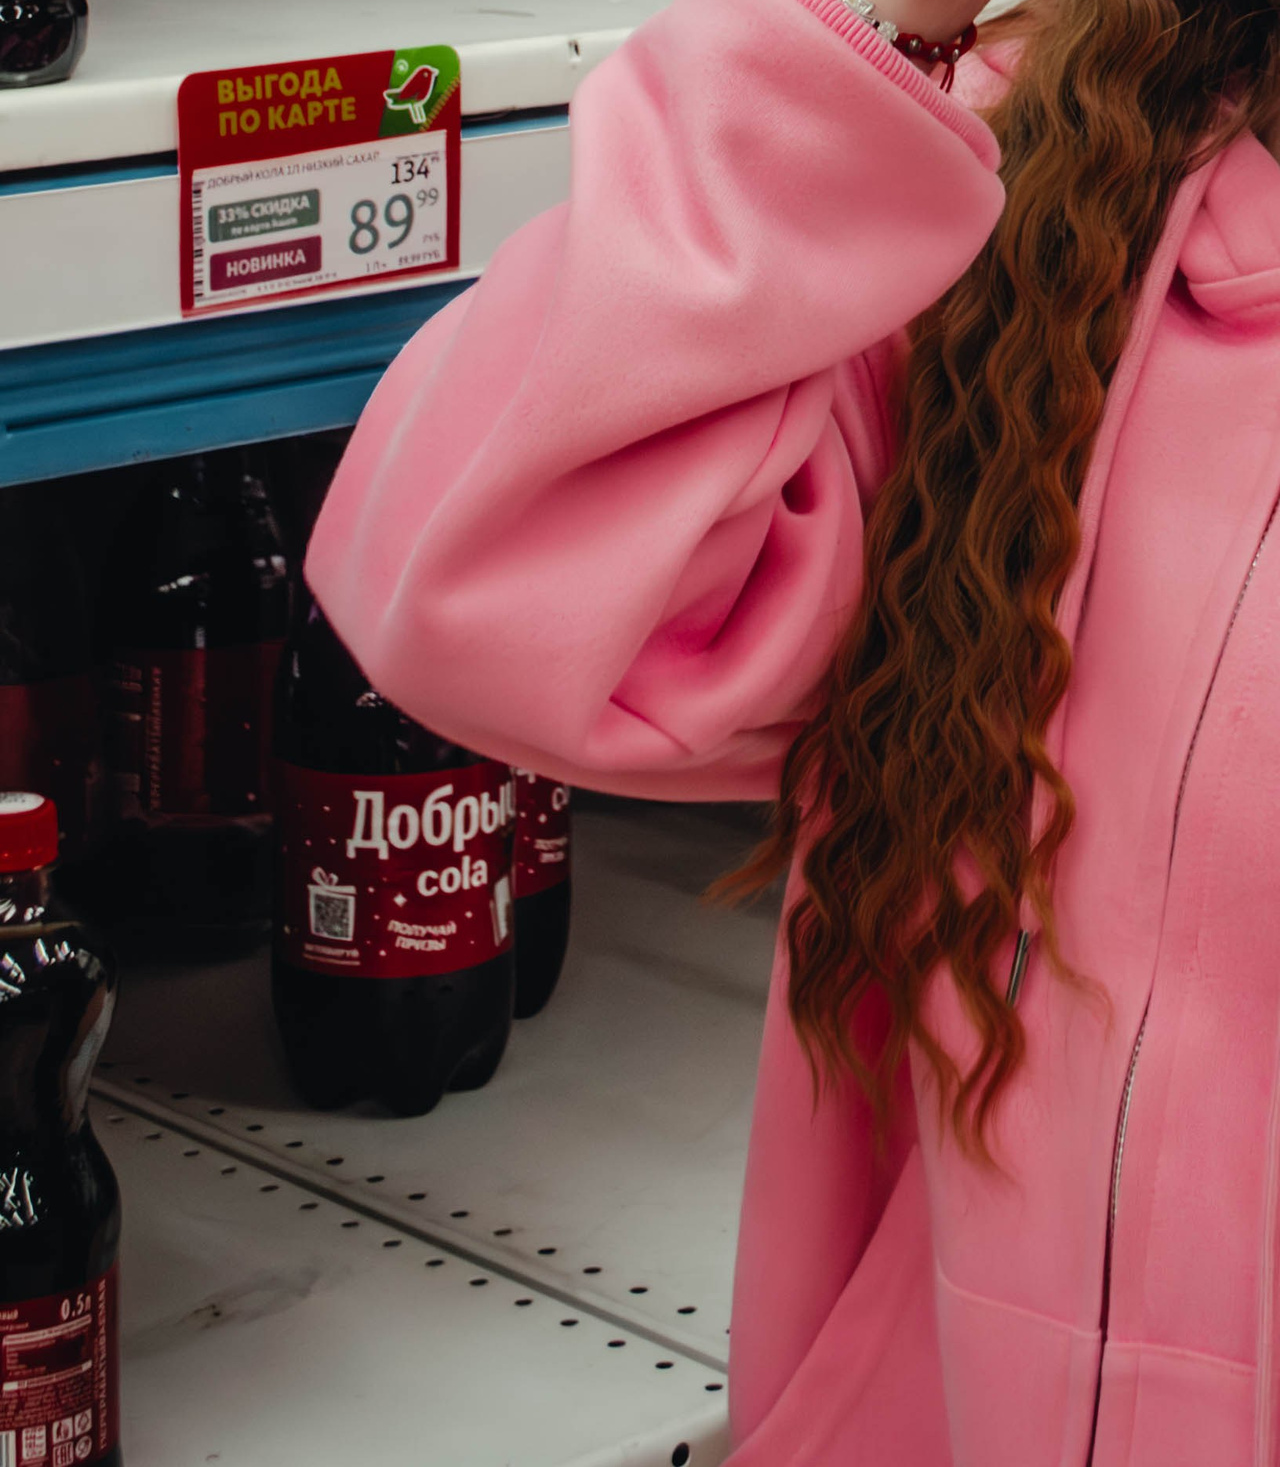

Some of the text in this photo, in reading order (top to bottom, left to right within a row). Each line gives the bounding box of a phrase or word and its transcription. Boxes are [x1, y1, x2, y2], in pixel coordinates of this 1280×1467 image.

[216, 66, 343, 105] ВЫГОДА
[218, 97, 357, 137] ПО КАРТЕ
[255, 166, 285, 181] КОЛА
[301, 156, 345, 173] НИЗКИЙ
[391, 157, 430, 185] 134
[250, 194, 311, 219] СКИДКА
[349, 193, 414, 255] 89
[226, 248, 307, 279] НОВИНКА
[416, 854, 489, 897] cola
